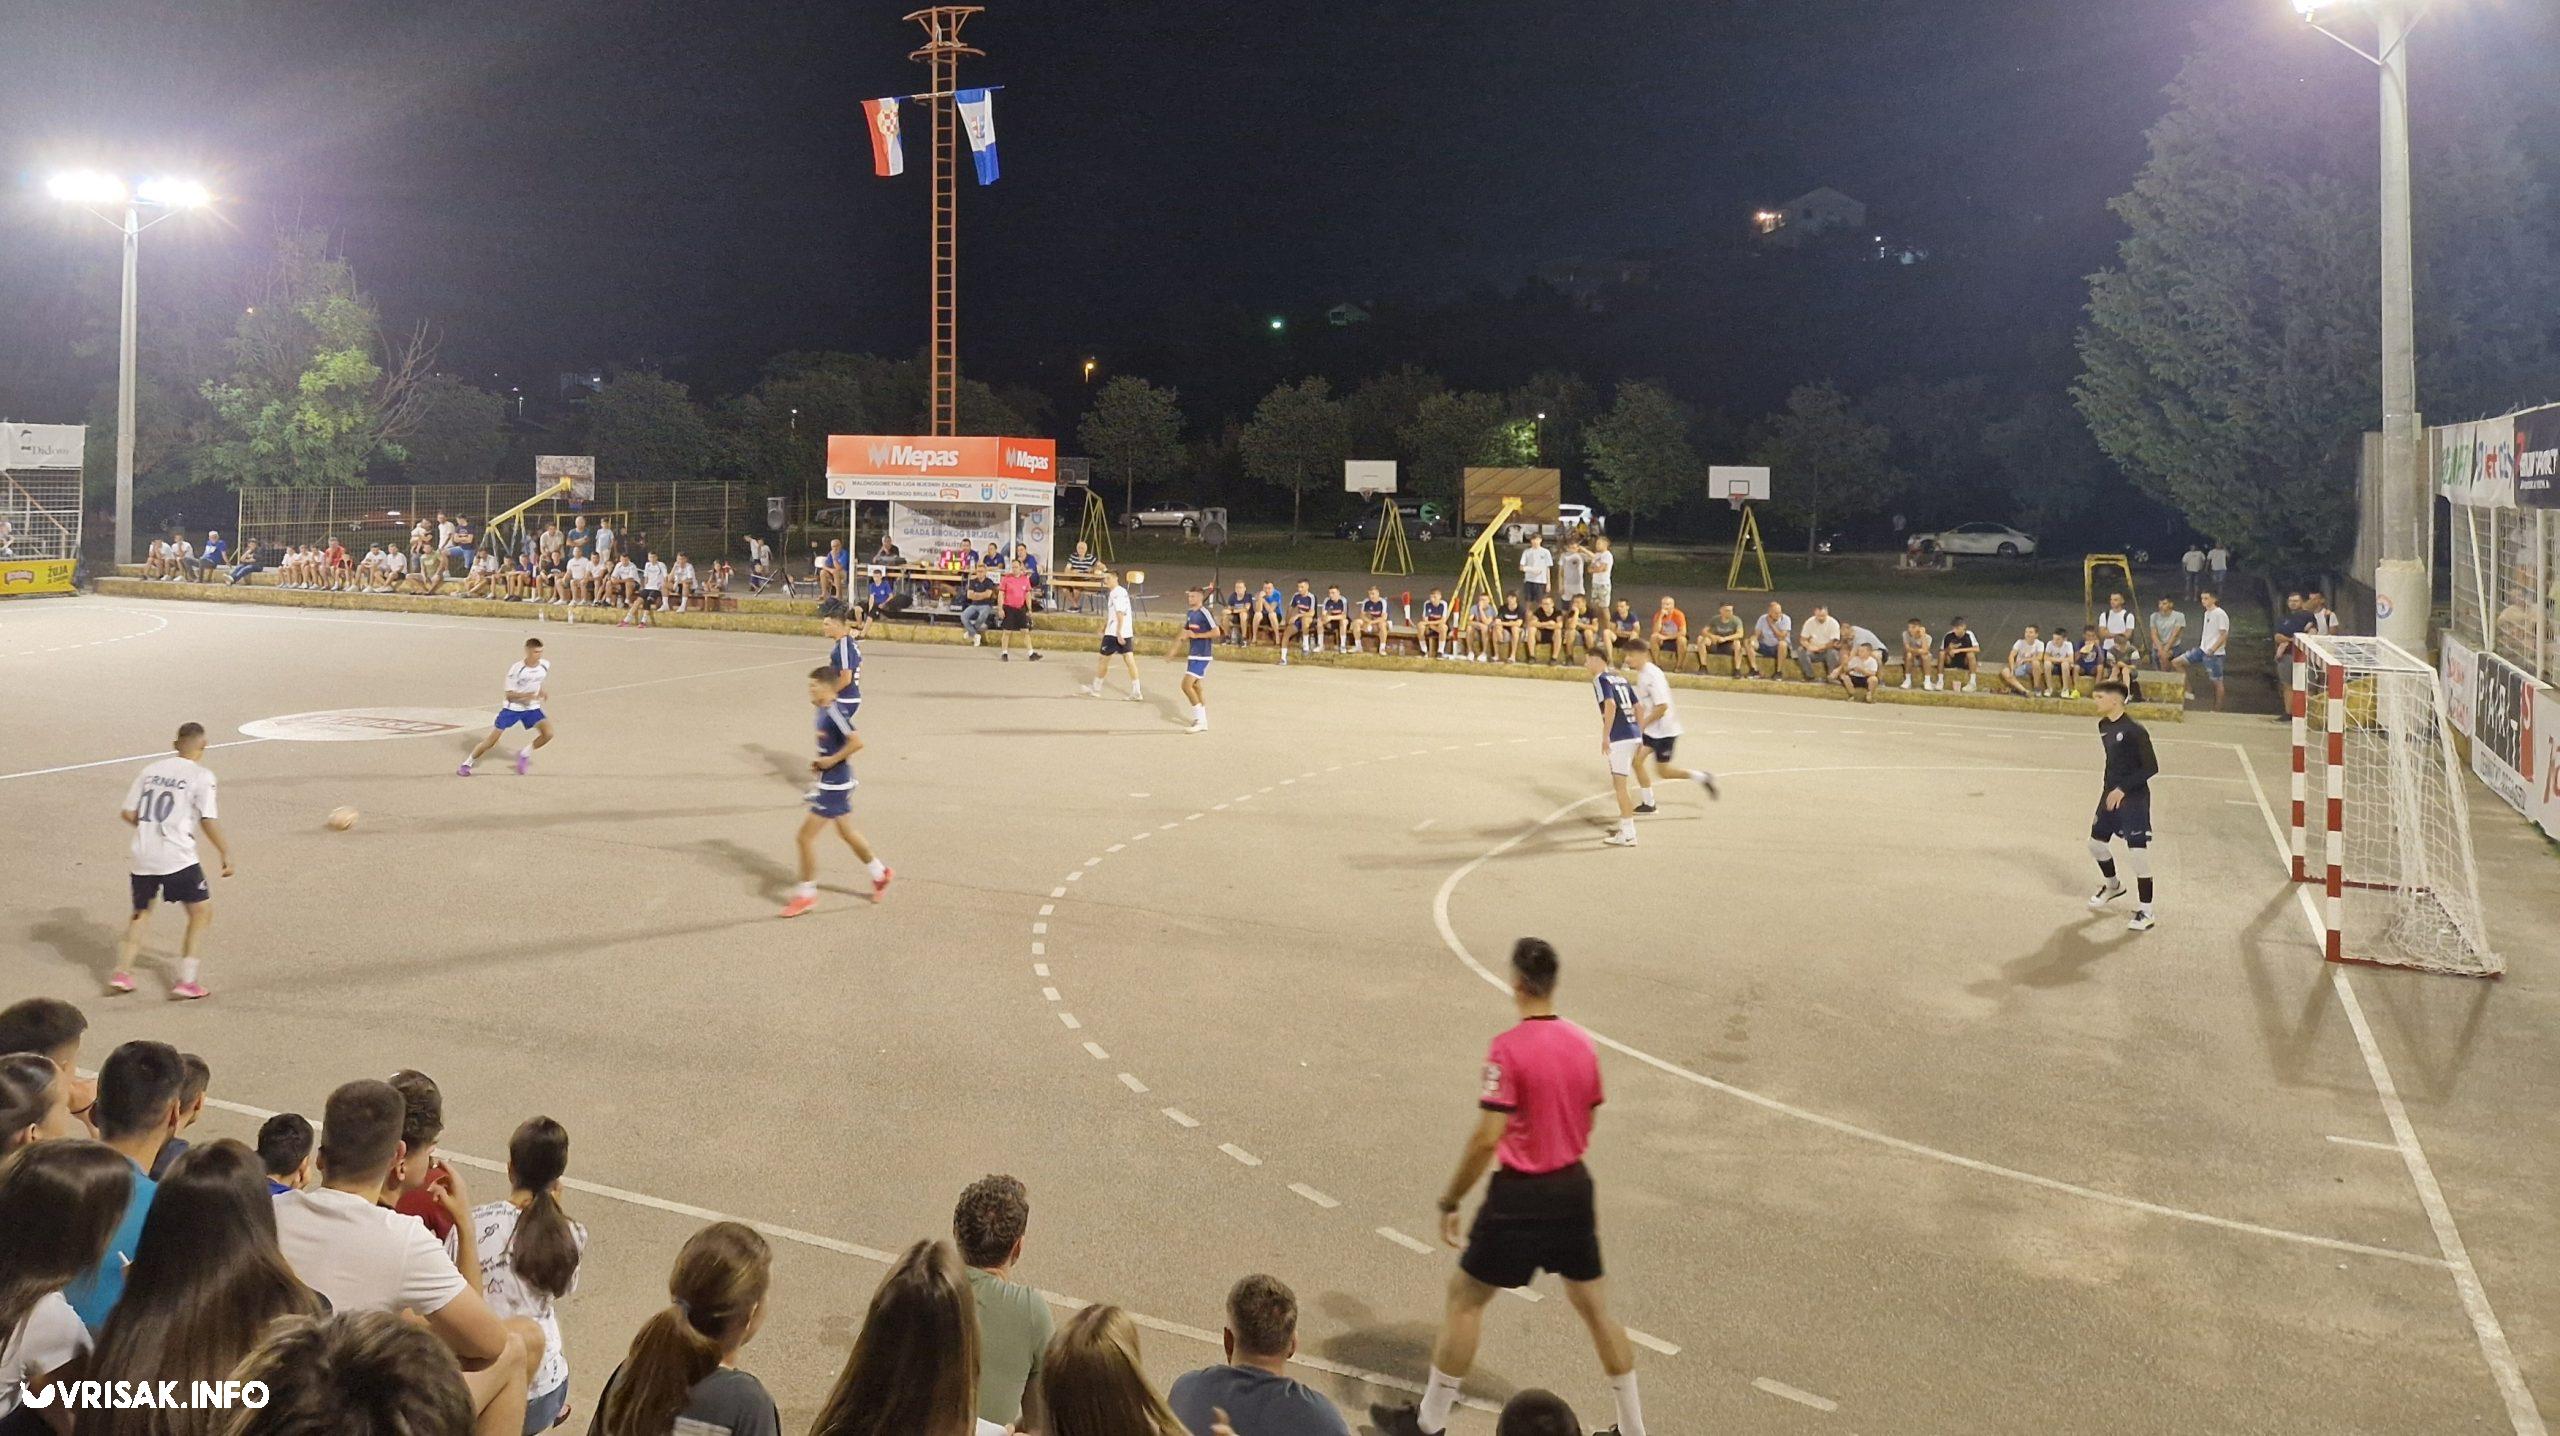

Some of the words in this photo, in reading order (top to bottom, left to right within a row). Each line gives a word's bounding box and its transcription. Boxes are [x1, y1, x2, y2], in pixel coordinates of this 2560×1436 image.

[890, 445, 959, 472] Mepas
[1016, 450, 1049, 474] Mepas
[903, 528, 930, 537] GRADA
[1614, 684, 1632, 709] 11
[138, 789, 175, 823] 10
